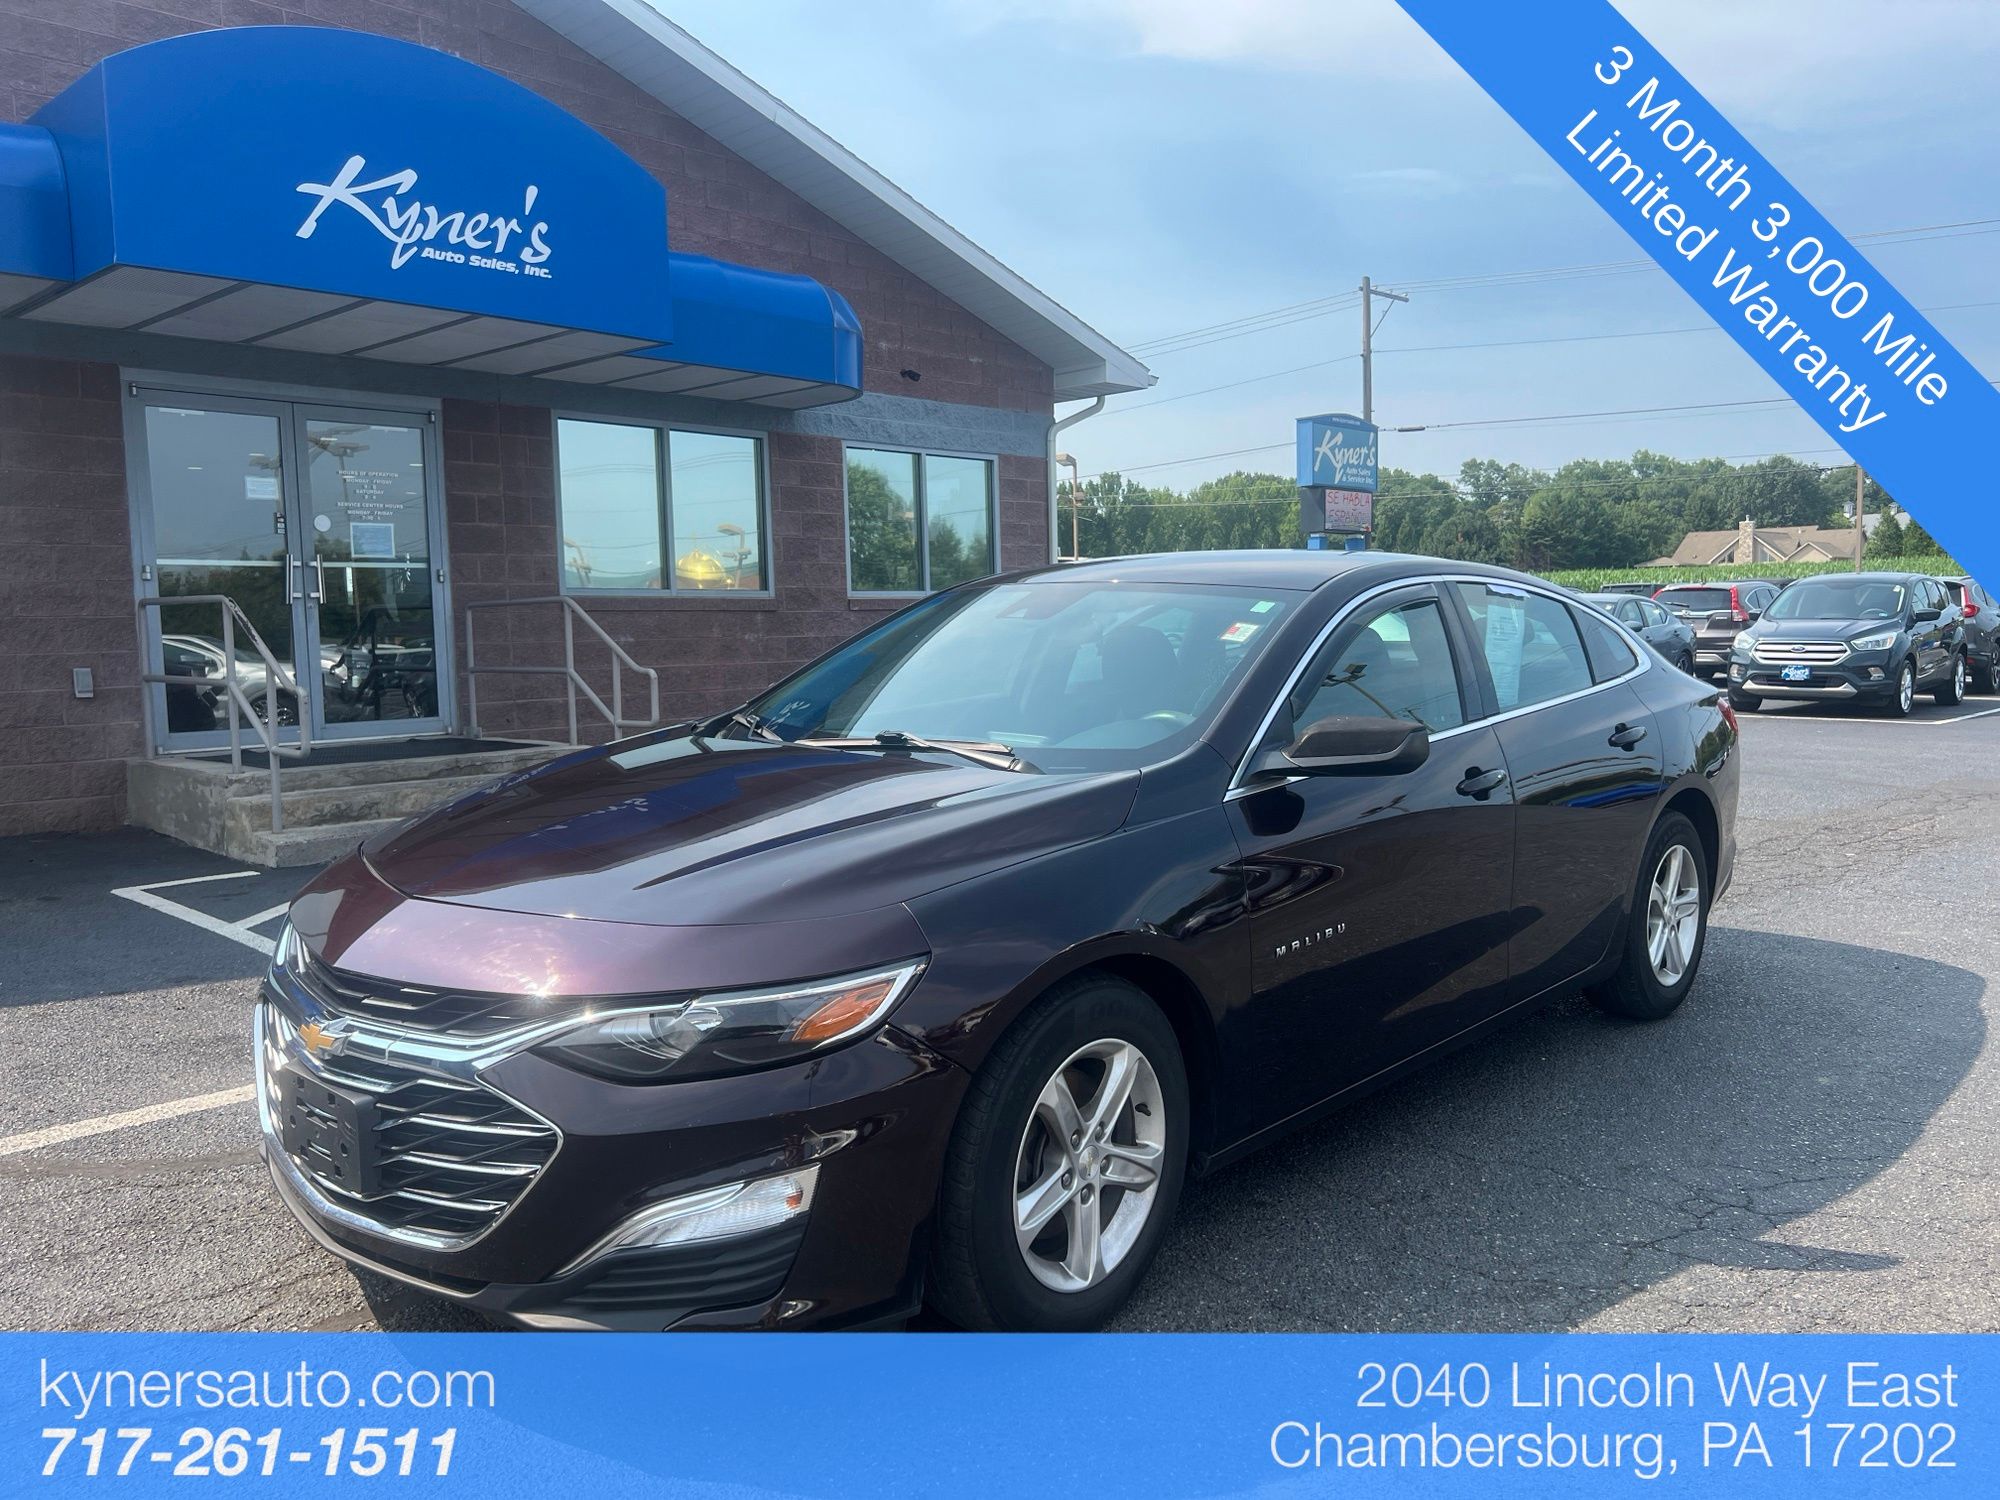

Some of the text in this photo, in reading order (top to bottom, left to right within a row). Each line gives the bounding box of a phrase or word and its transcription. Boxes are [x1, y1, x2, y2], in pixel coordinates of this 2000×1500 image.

[295, 154, 552, 270] Kyner's
[420, 247, 553, 279] Auto Sales, Inc.
[1314, 429, 1376, 484] Kyner's
[1275, 922, 1346, 958] MALIBU
